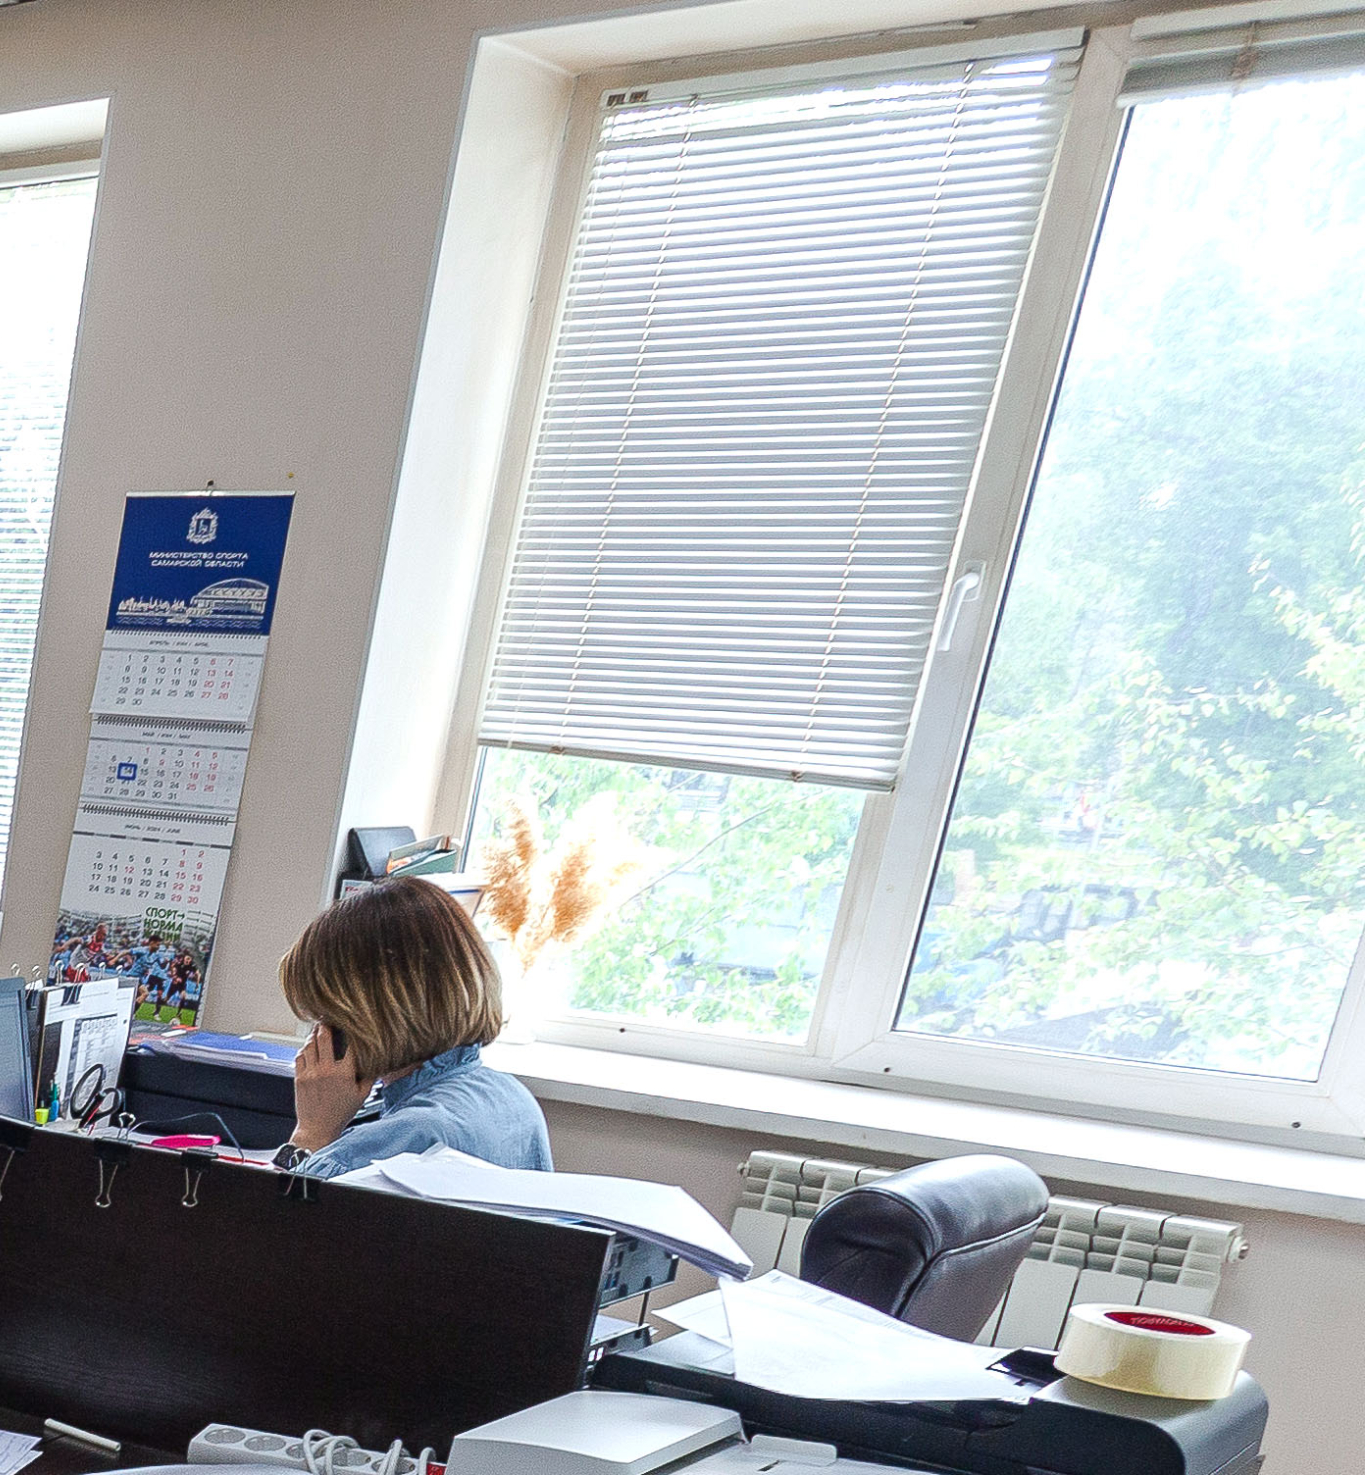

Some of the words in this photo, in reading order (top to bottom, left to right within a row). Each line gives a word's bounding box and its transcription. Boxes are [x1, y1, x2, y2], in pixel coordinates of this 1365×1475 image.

[121, 888, 130, 896] 26
[154, 892, 165, 900] 28
[171, 894, 182, 902] 29
[188, 896, 198, 904] 30
[146, 907, 177, 919] СПОРТ
[144, 918, 183, 931] НОРМА
